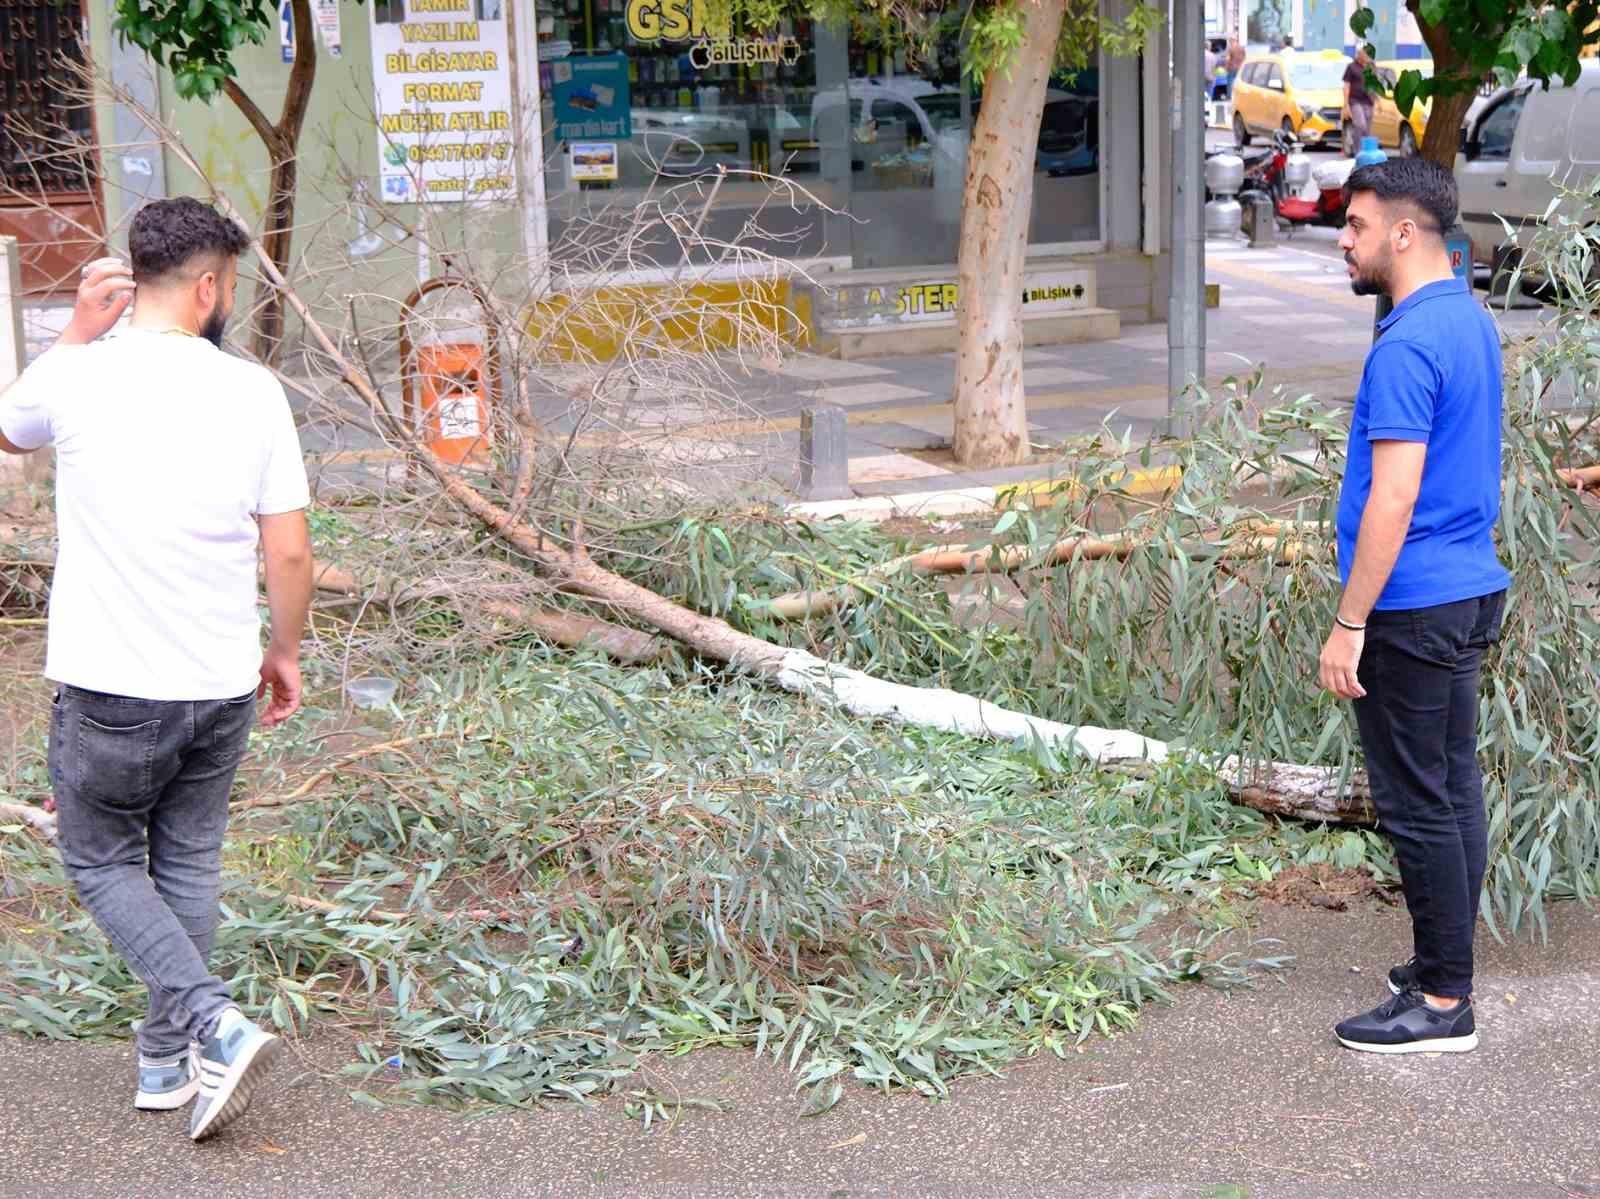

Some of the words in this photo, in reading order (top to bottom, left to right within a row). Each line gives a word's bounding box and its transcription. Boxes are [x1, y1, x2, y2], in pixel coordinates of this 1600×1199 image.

[400, 22, 480, 42] YAZILIM
[386, 49, 498, 73] BİLGİSAYAR
[404, 81, 484, 103] FORMAT
[383, 108, 445, 132] MÜZİK
[449, 111, 509, 131] ATILIR
[1031, 284, 1071, 301] BİLİŞİM
